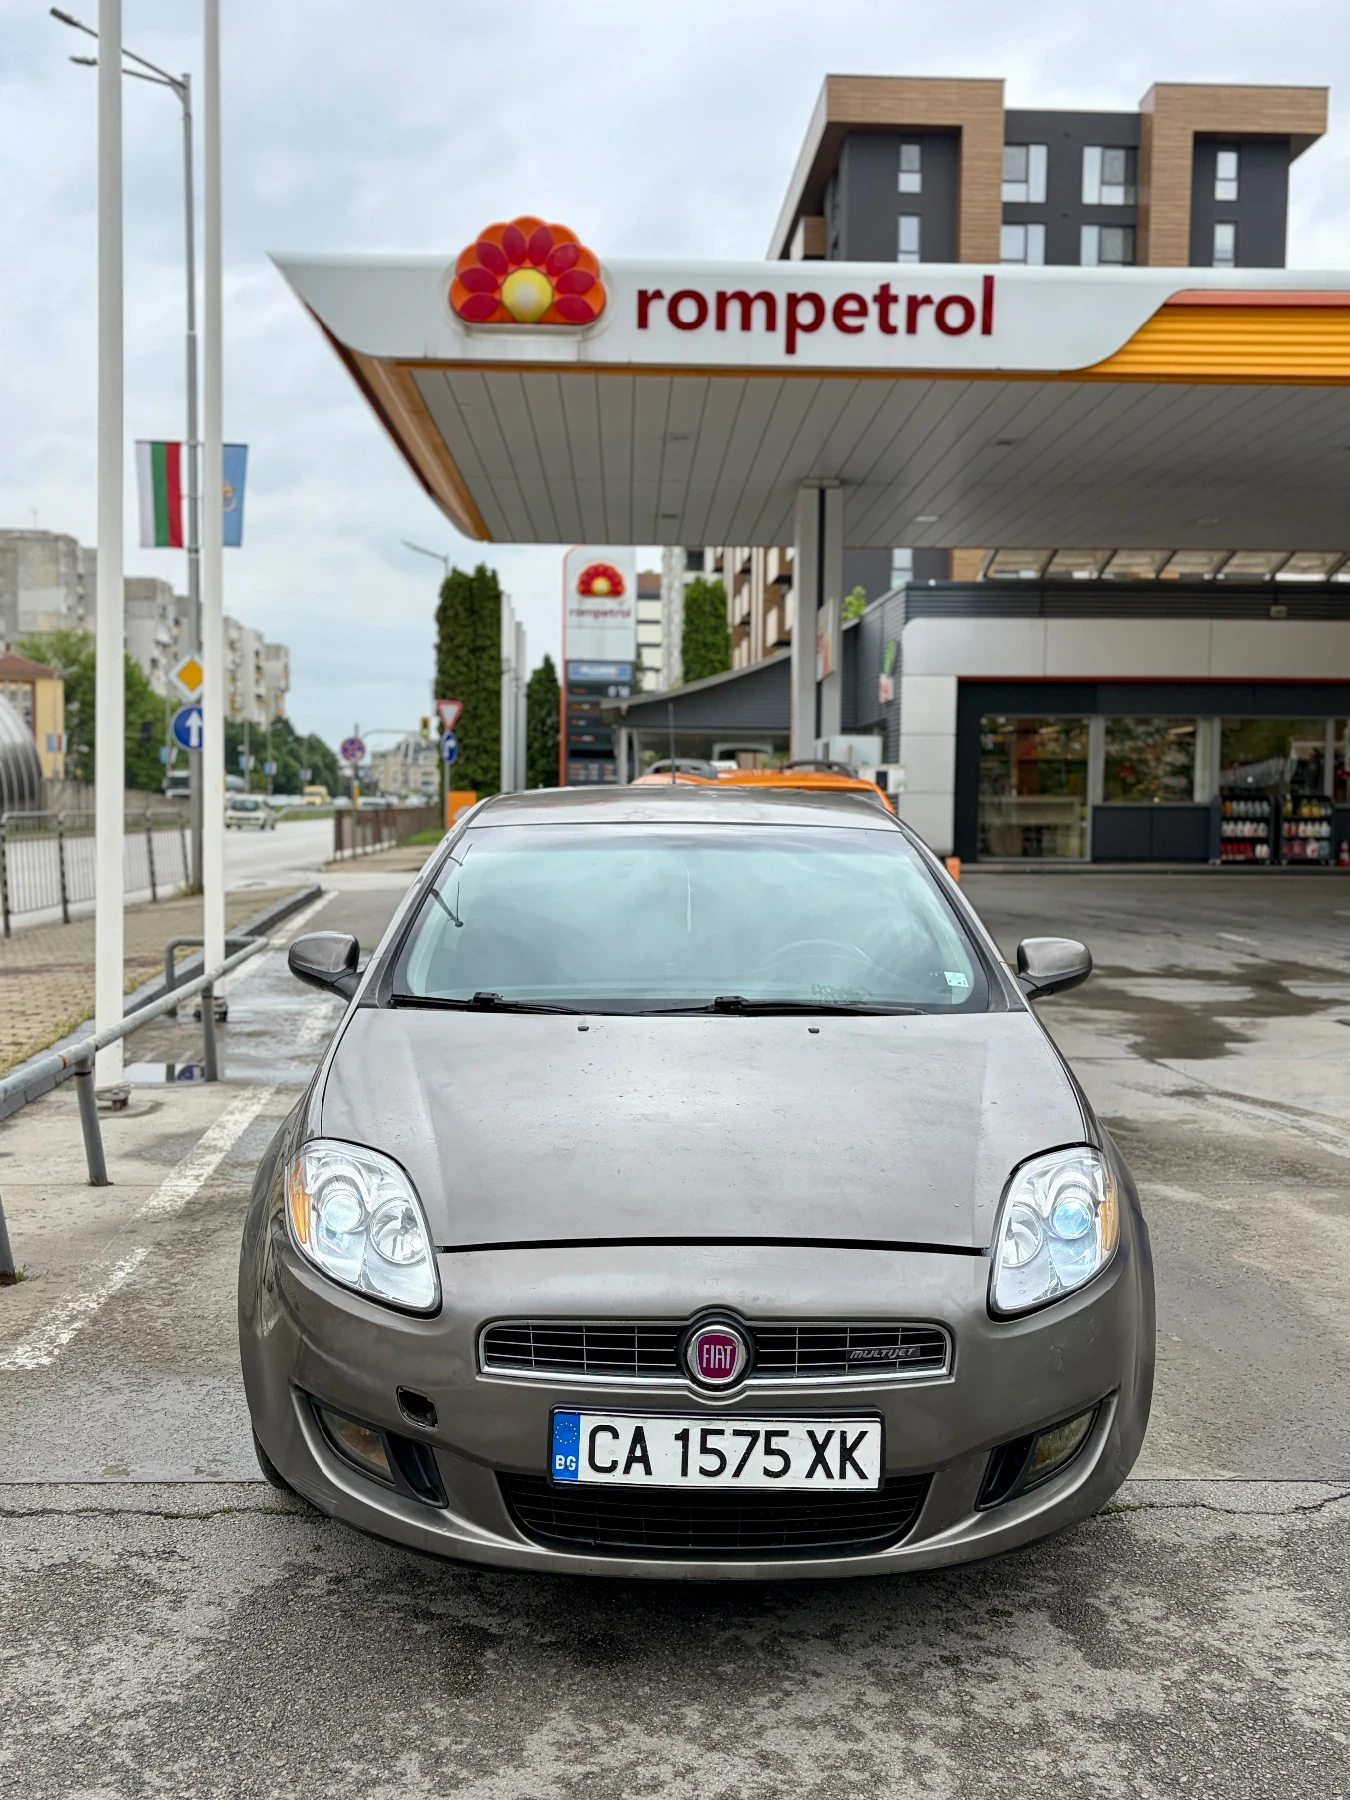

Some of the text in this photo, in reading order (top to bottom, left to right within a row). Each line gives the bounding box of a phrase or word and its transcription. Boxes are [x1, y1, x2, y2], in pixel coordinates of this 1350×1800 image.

[636, 274, 994, 355] rompetrol
[702, 1344, 733, 1369] FIAT
[850, 1347, 916, 1359] MULTIJET
[555, 1454, 577, 1471] BG
[588, 1424, 869, 1480] CA 1575 XK
